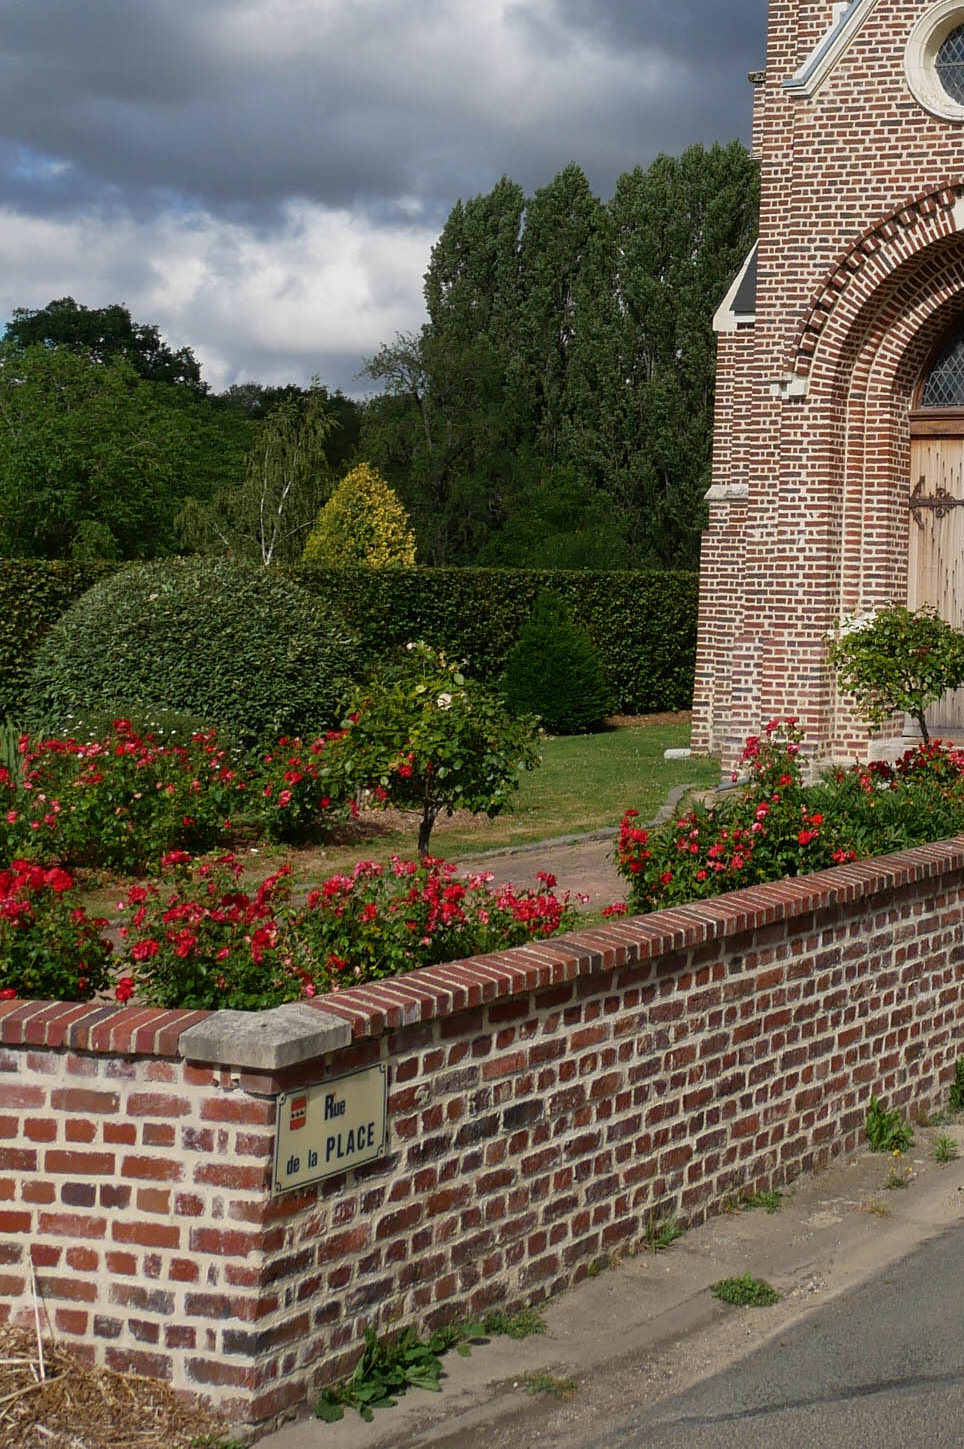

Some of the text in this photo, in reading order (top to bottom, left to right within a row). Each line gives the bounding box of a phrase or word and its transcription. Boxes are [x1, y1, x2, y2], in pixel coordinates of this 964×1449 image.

[324, 1094, 346, 1121] Rue
[286, 1122, 375, 1175] de la PLACE
